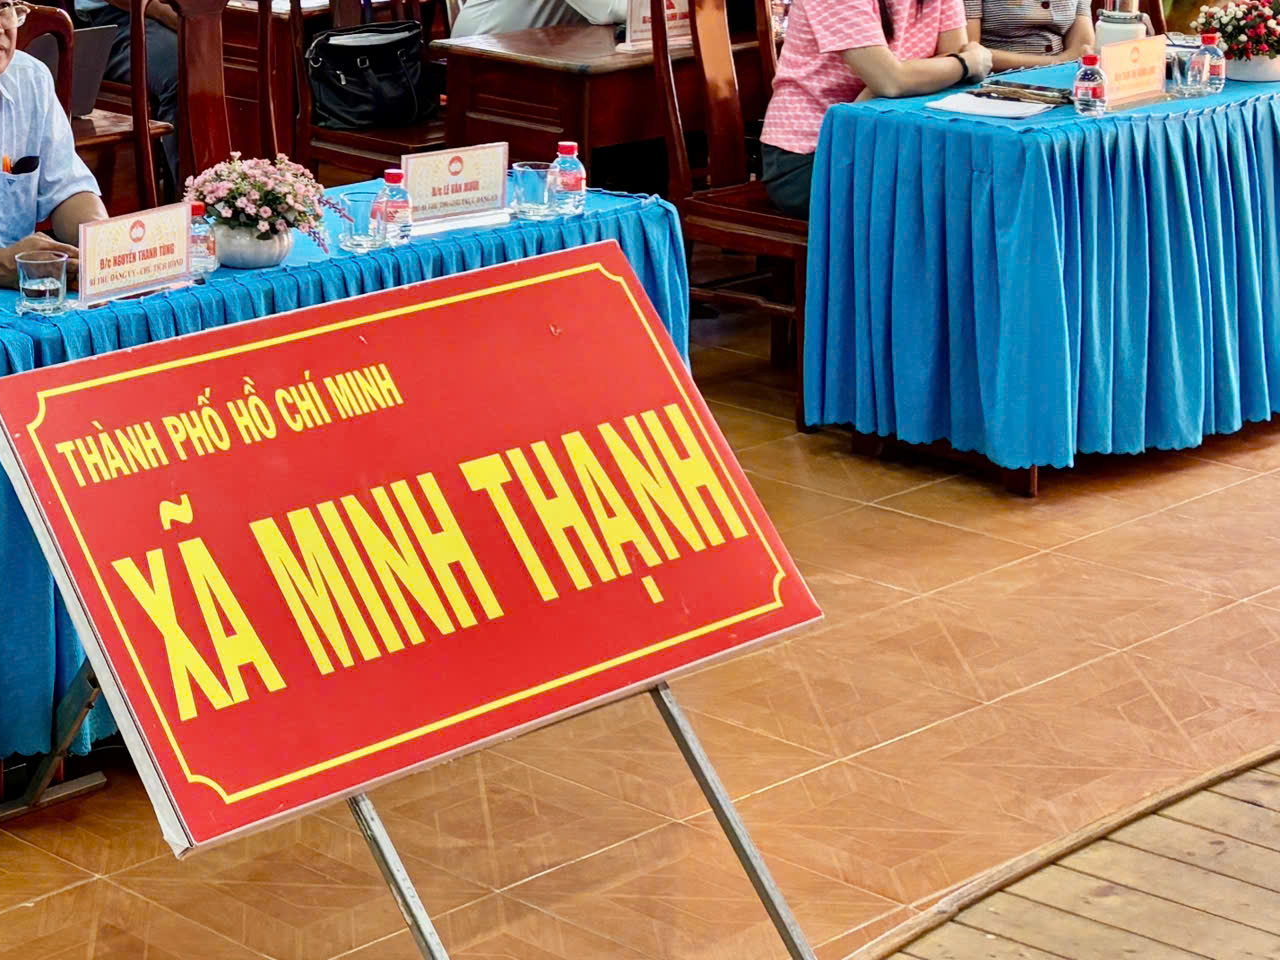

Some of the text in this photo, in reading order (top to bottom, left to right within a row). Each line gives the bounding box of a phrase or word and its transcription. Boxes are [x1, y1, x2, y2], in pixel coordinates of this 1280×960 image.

[56, 362, 404, 488] THÀNH PHỐ HỒ CHÍ MINH
[111, 403, 748, 722] XÃ MINH THẠNH
